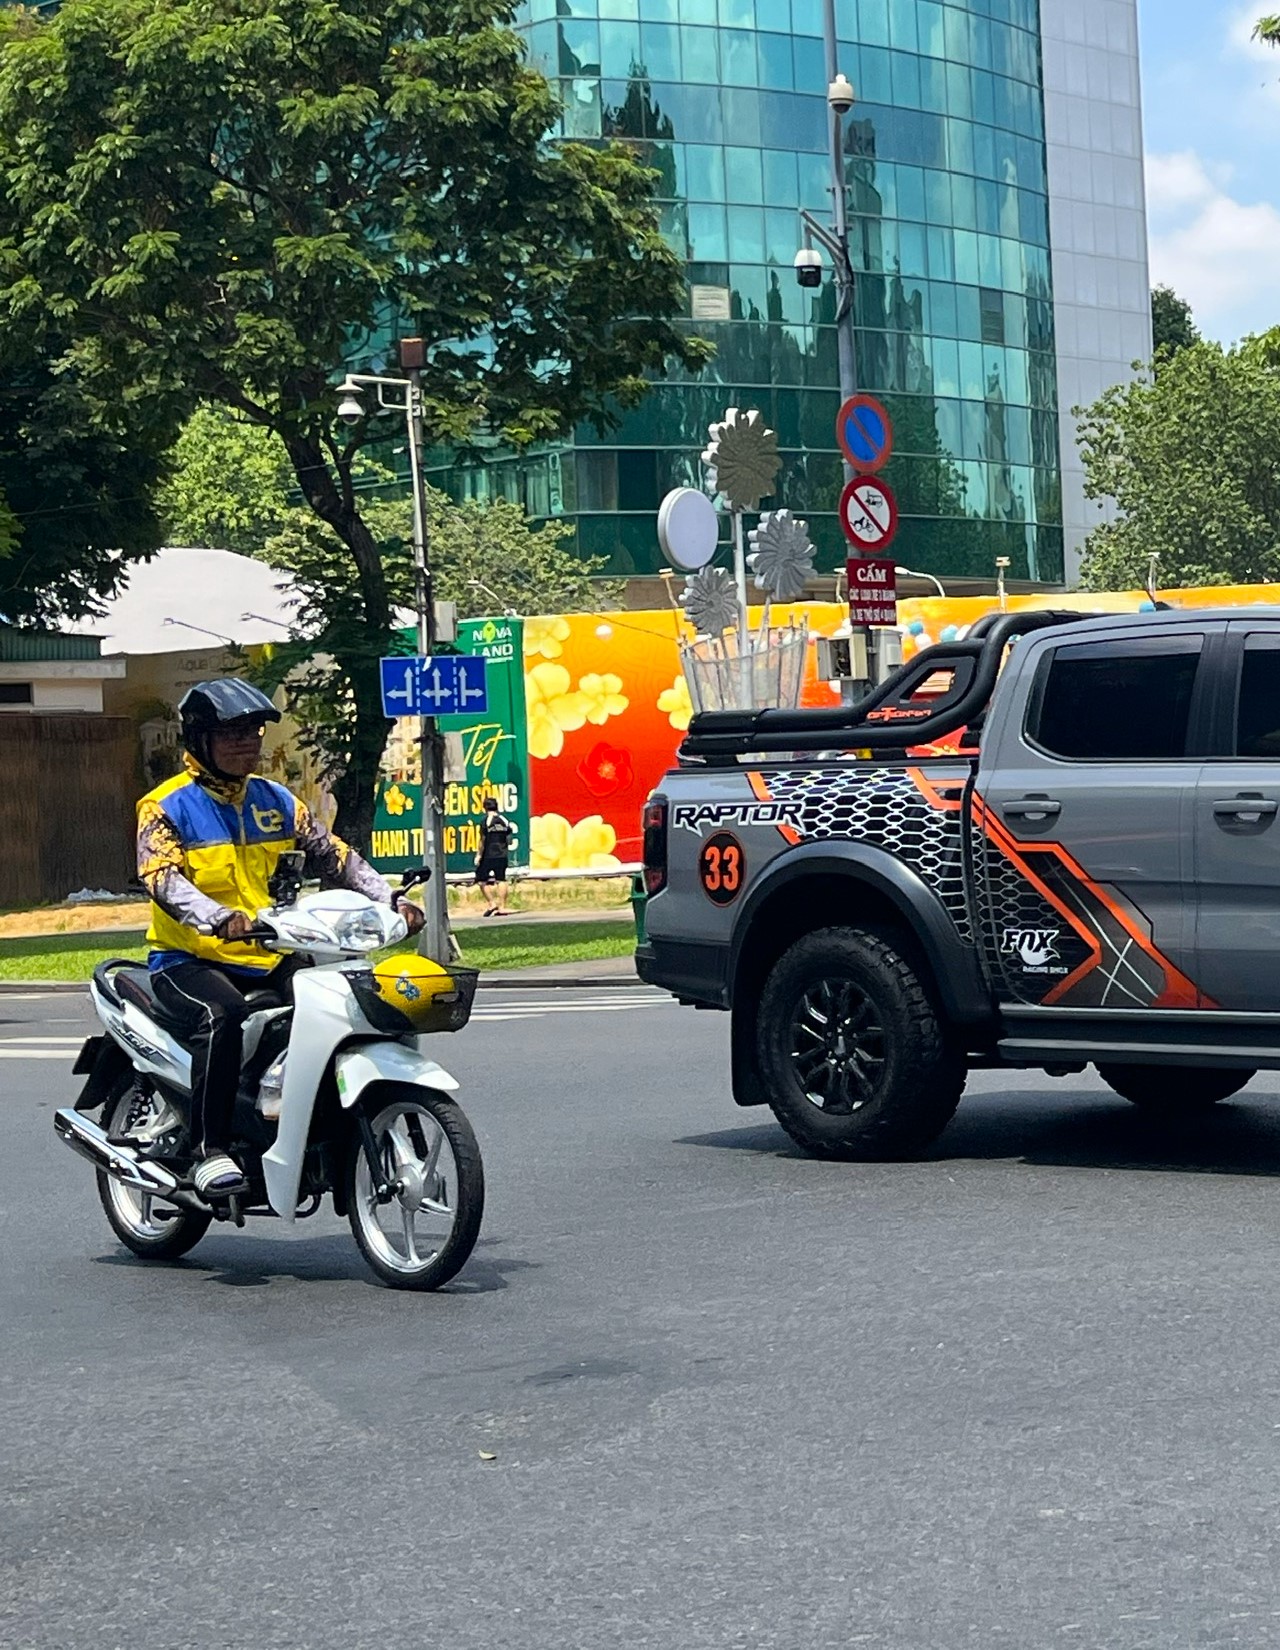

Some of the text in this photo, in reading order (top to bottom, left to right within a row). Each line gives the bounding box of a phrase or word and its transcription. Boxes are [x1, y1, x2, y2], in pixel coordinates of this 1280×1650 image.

[856, 562, 887, 582] CẤM
[673, 801, 807, 838] RAPTOR
[372, 829, 409, 858] HANH
[705, 846, 739, 891] 33
[1000, 929, 1059, 954] FOX
